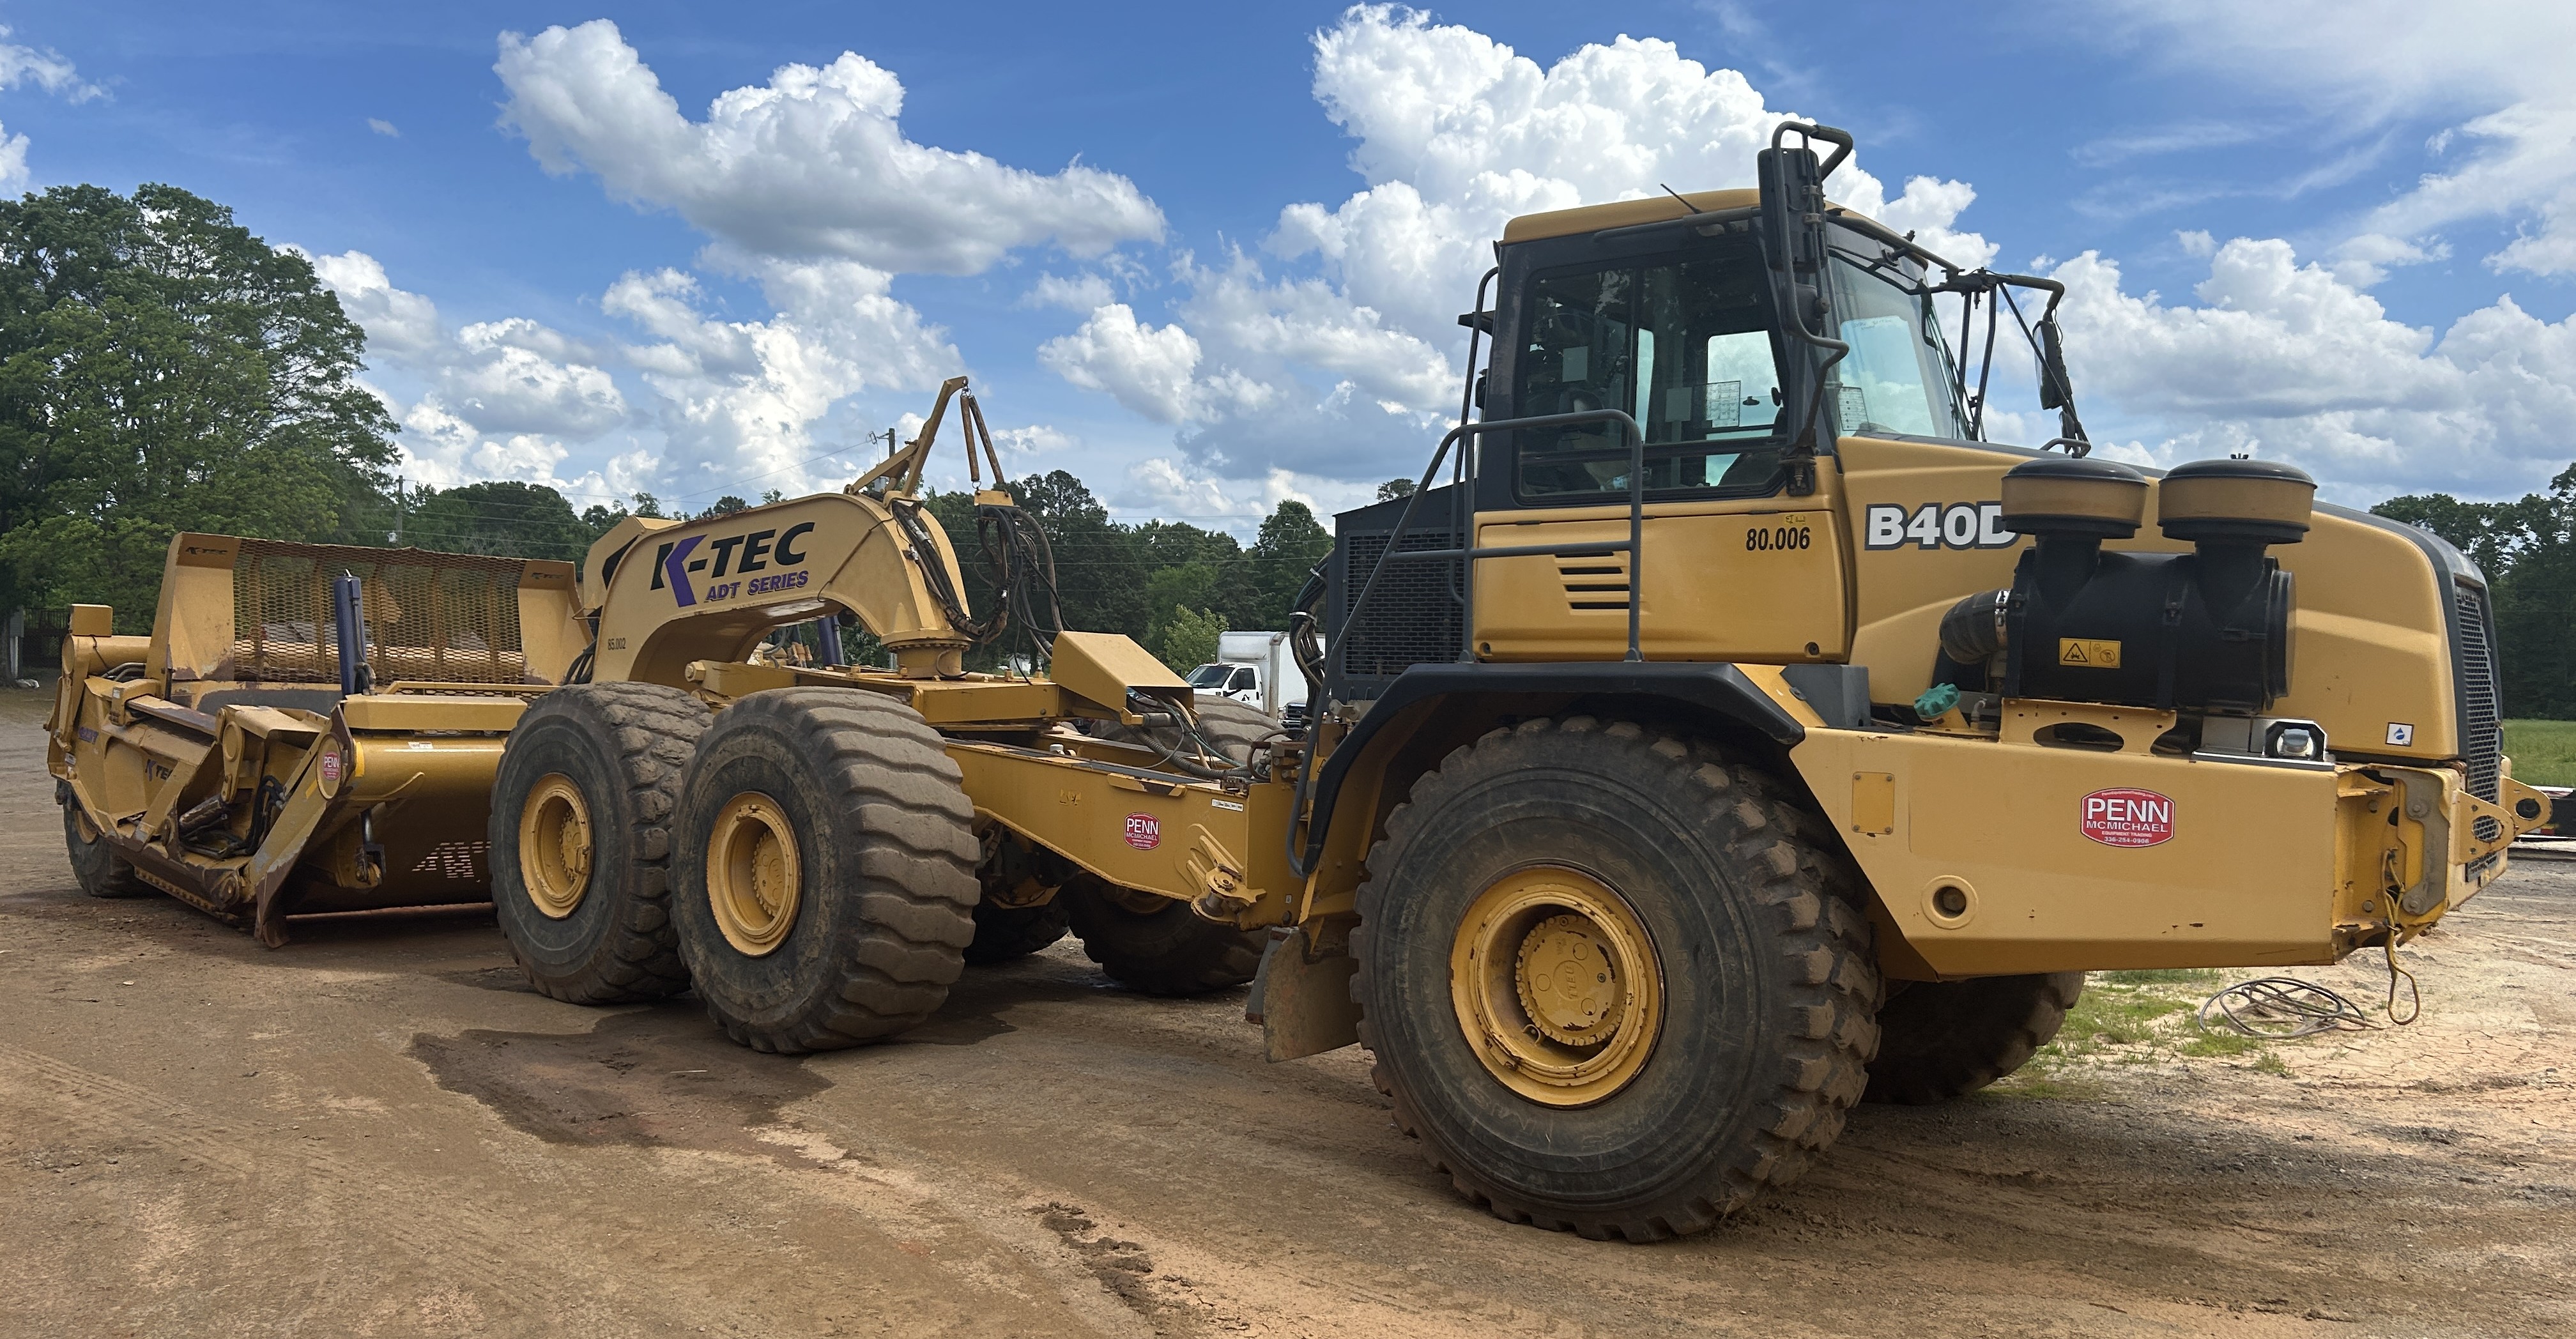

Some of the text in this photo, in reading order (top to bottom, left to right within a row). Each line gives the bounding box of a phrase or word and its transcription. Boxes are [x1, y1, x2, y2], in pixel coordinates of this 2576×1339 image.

[1867, 503, 2018, 547] B40D
[1746, 527, 1810, 551] 80.006
[650, 522, 815, 608] K-TEC
[703, 570, 809, 602] ADT SERIES
[324, 756, 339, 768] PENN
[2087, 798, 2168, 823] PENN
[1126, 818, 1158, 835] PENN
[2086, 820, 2168, 832] MCMICHAEL
